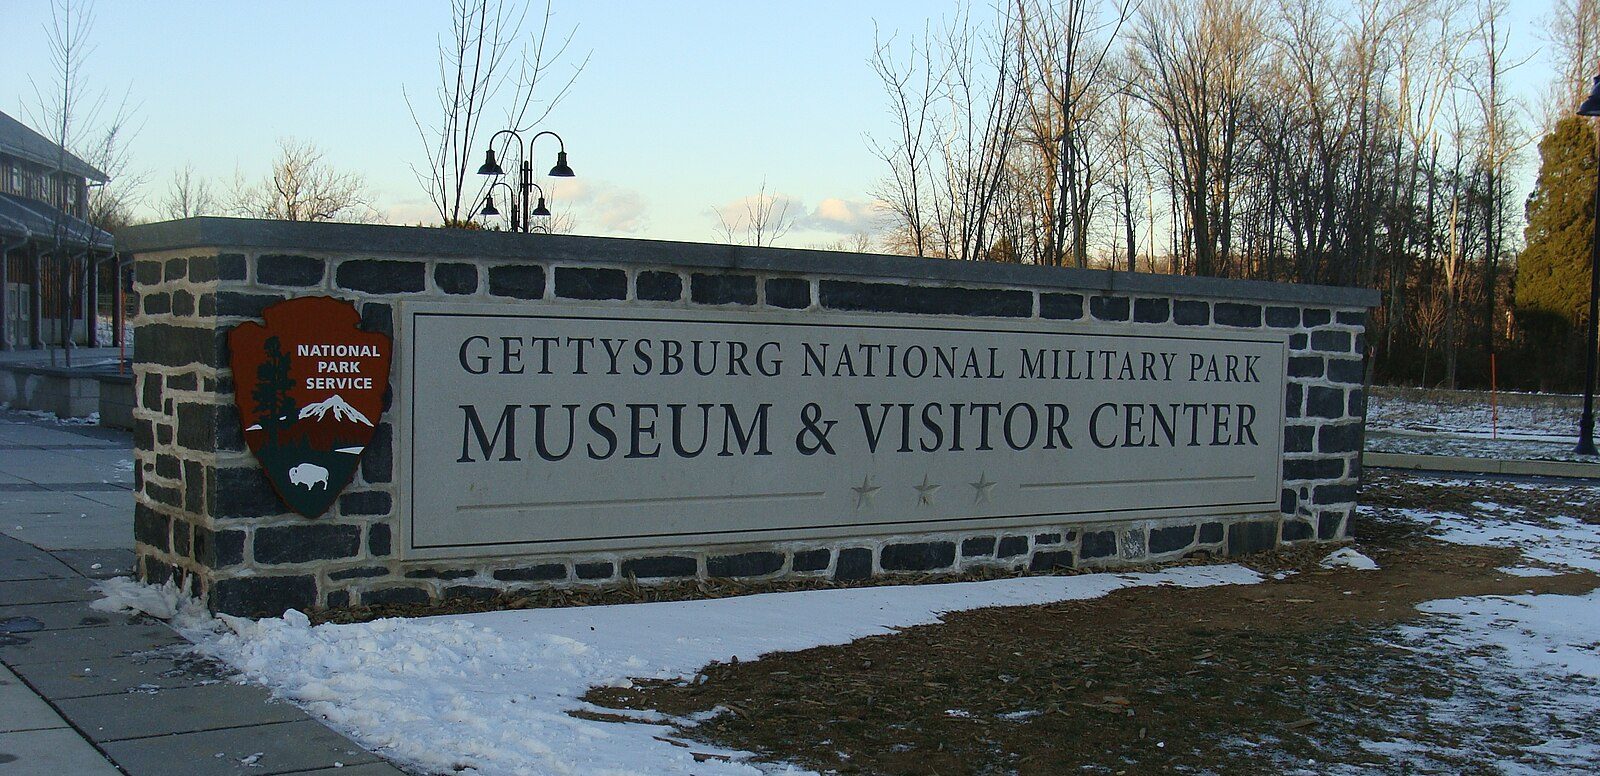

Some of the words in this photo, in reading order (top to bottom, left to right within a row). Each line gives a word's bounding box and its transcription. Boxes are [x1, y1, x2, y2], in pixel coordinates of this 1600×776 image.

[297, 344, 381, 357] NATIONAL
[458, 335, 784, 377] GETTYSBURG
[801, 341, 1005, 379] NATIONAL
[1018, 347, 1178, 381] MILITARY
[1188, 352, 1261, 383] PARK
[317, 361, 361, 373] PARK
[305, 377, 373, 390] SERVICE
[456, 402, 773, 463] MUSEUM
[795, 402, 839, 456] &
[854, 402, 1074, 454] VISITOR
[1088, 402, 1259, 449] CENTER
